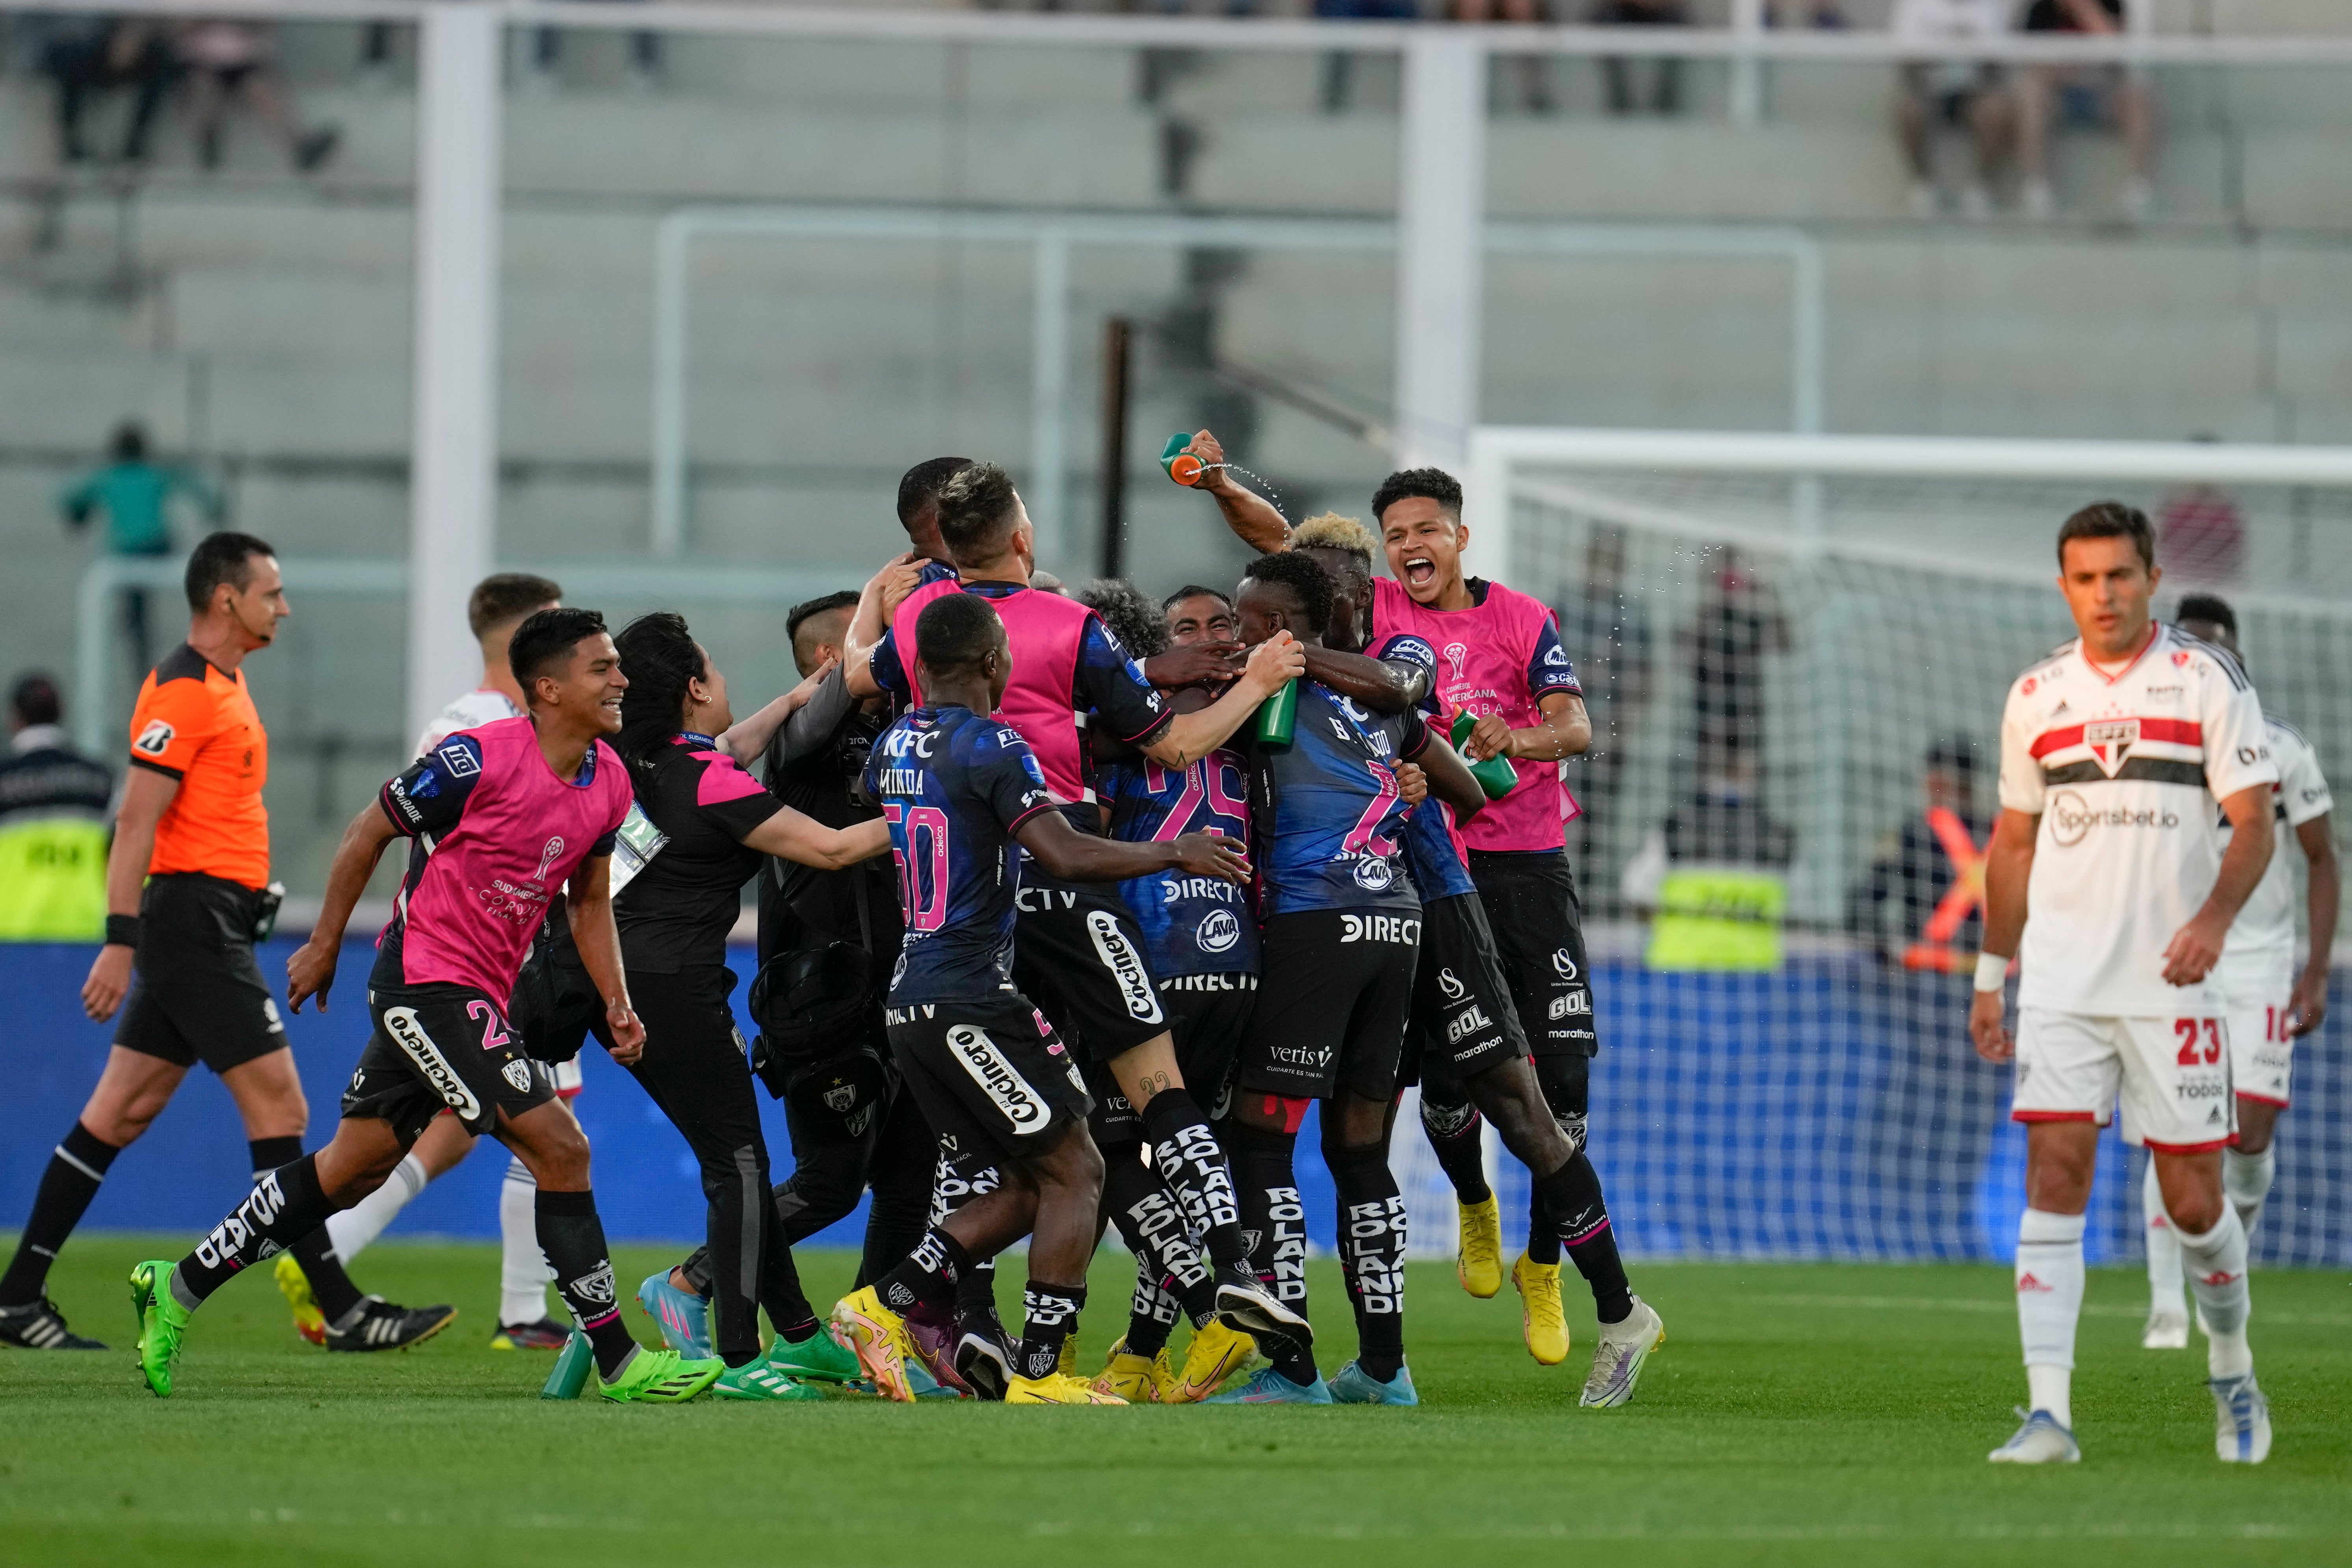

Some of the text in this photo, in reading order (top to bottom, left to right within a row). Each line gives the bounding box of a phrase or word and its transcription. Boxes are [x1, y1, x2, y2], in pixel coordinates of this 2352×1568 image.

[1447, 689, 1497, 703] MERICANA
[883, 729, 941, 758] KFC
[880, 769, 923, 795] MINDA
[2058, 806, 2179, 832] Sportsbet.io
[935, 826, 943, 857] adelca
[1199, 918, 1238, 942] LAVA
[1341, 914, 1421, 946] DIRECT
[1095, 919, 1154, 1019] Cocinero
[1452, 994, 1475, 1007] Schwarzkopf
[1549, 989, 1592, 1020] GOL
[466, 999, 520, 1051] 2
[1447, 1004, 1493, 1044] GOL
[1548, 1028, 1594, 1039] marathon
[982, 1038, 1004, 1065] Comestible
[1270, 1046, 1316, 1065] veris
[1454, 1036, 1503, 1062] marathon
[2175, 1017, 2220, 1066] 23
[391, 1016, 469, 1109] Cocinero
[955, 1031, 1039, 1123] Cocinero
[1004, 1065, 1019, 1083] Vegetal
[1266, 1066, 1296, 1074] CUIDARTE
[956, 1152, 972, 1163] FÁCIL
[1175, 1124, 1237, 1227] ROLAND
[195, 1171, 285, 1269] ROLAND
[1126, 1193, 1208, 1288] ROLAND
[1265, 1187, 1306, 1300] ROLAND
[1349, 1202, 1393, 1313] ROLAND
